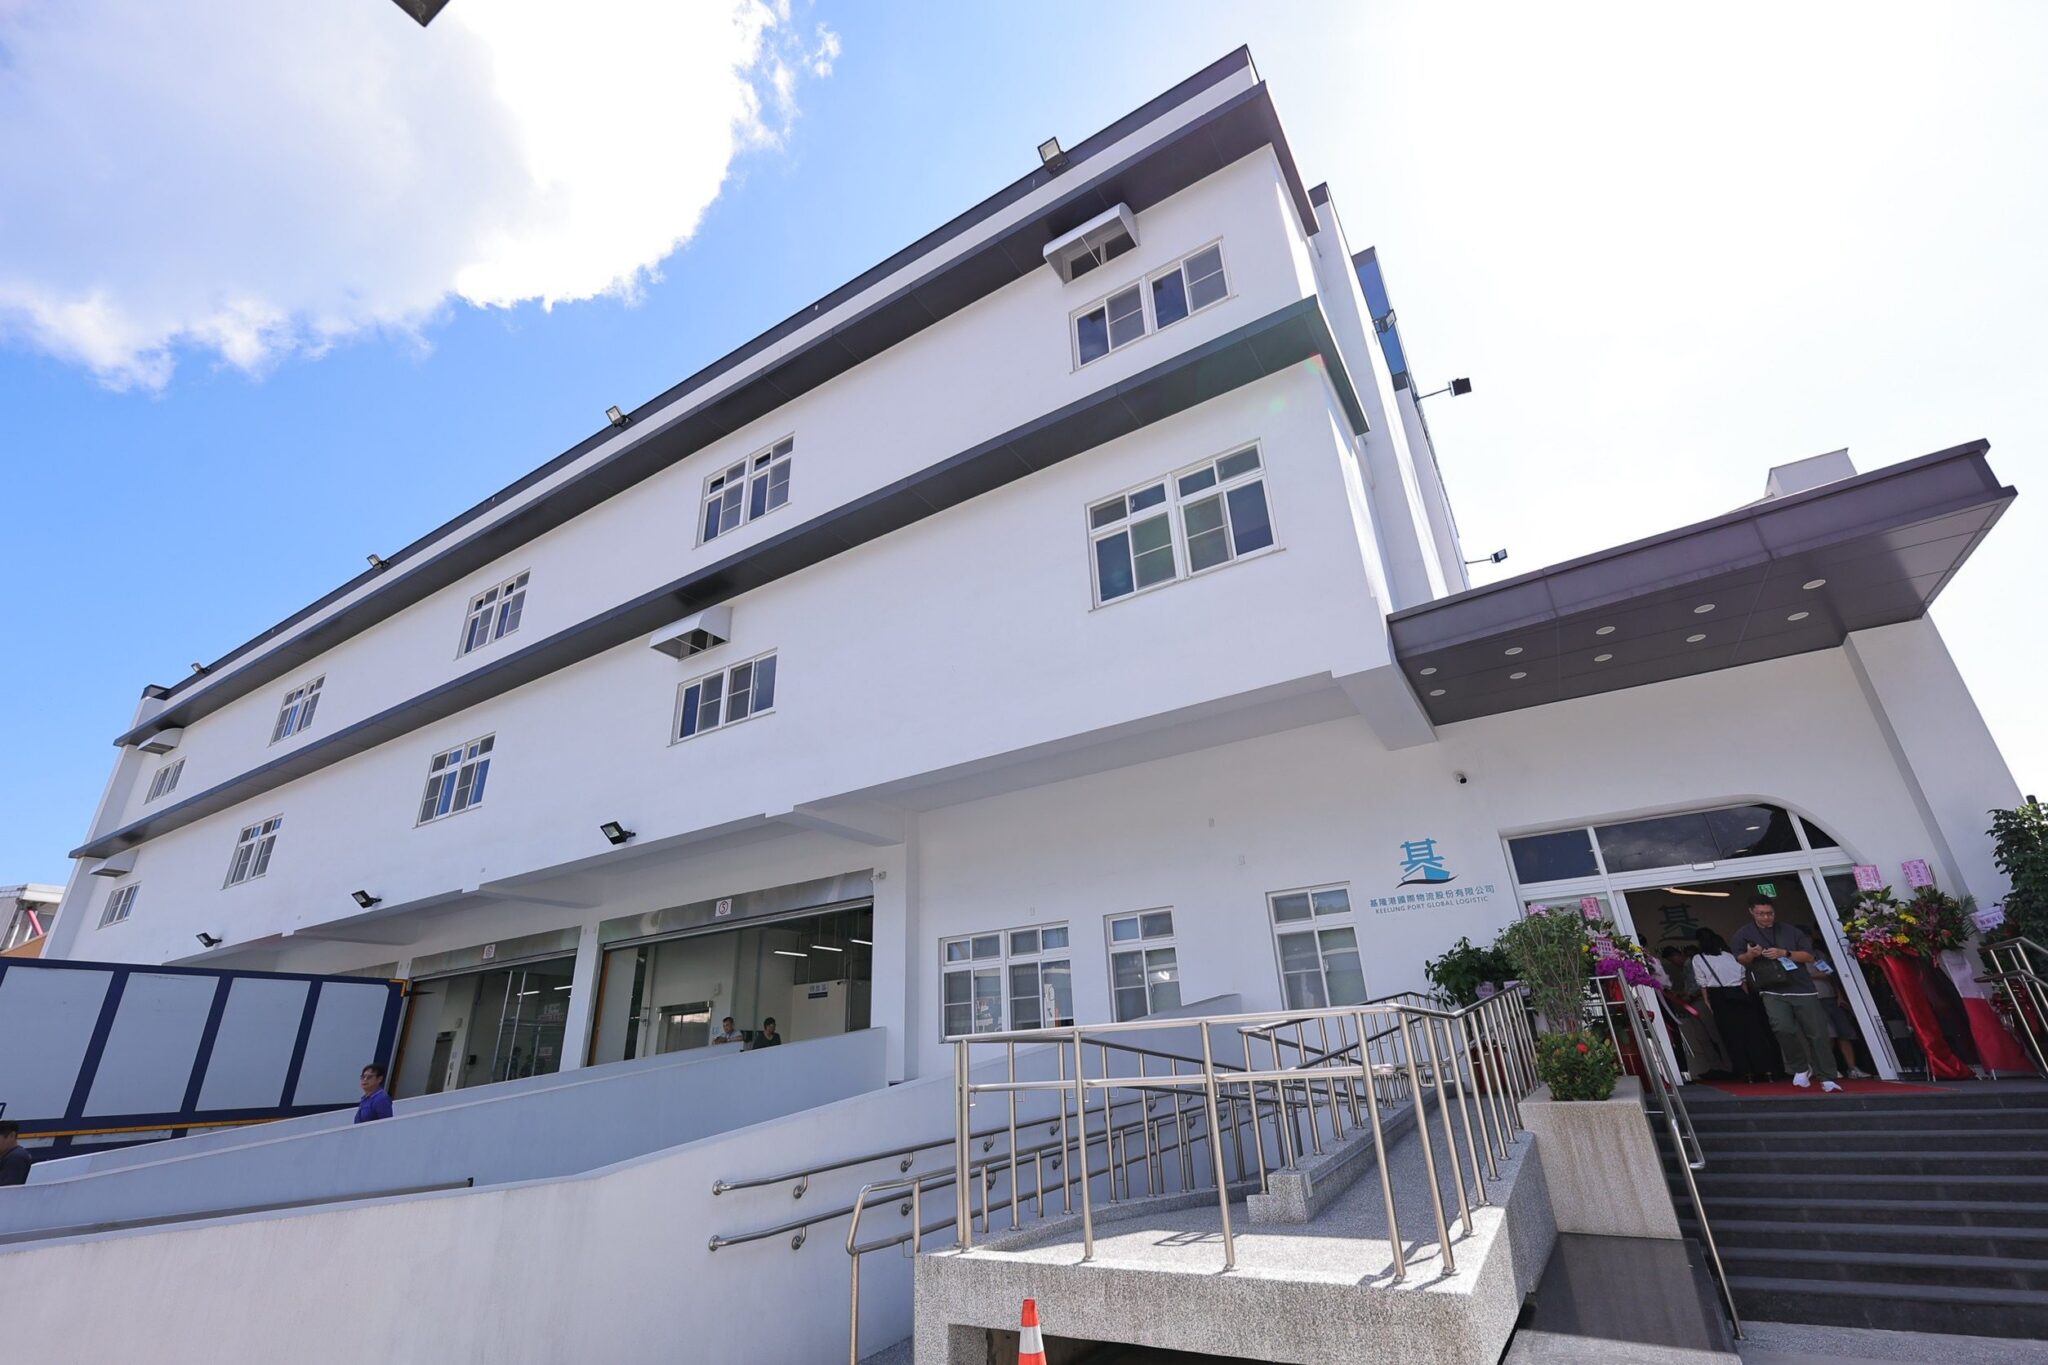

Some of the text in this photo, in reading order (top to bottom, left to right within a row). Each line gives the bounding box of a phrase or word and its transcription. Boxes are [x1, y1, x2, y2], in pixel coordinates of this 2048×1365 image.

[1370, 885, 1495, 908] 基隆港國際物流股份有限公司
[1375, 895, 1489, 914] KEELUNG PORT GLOBAL LOGISTIC
